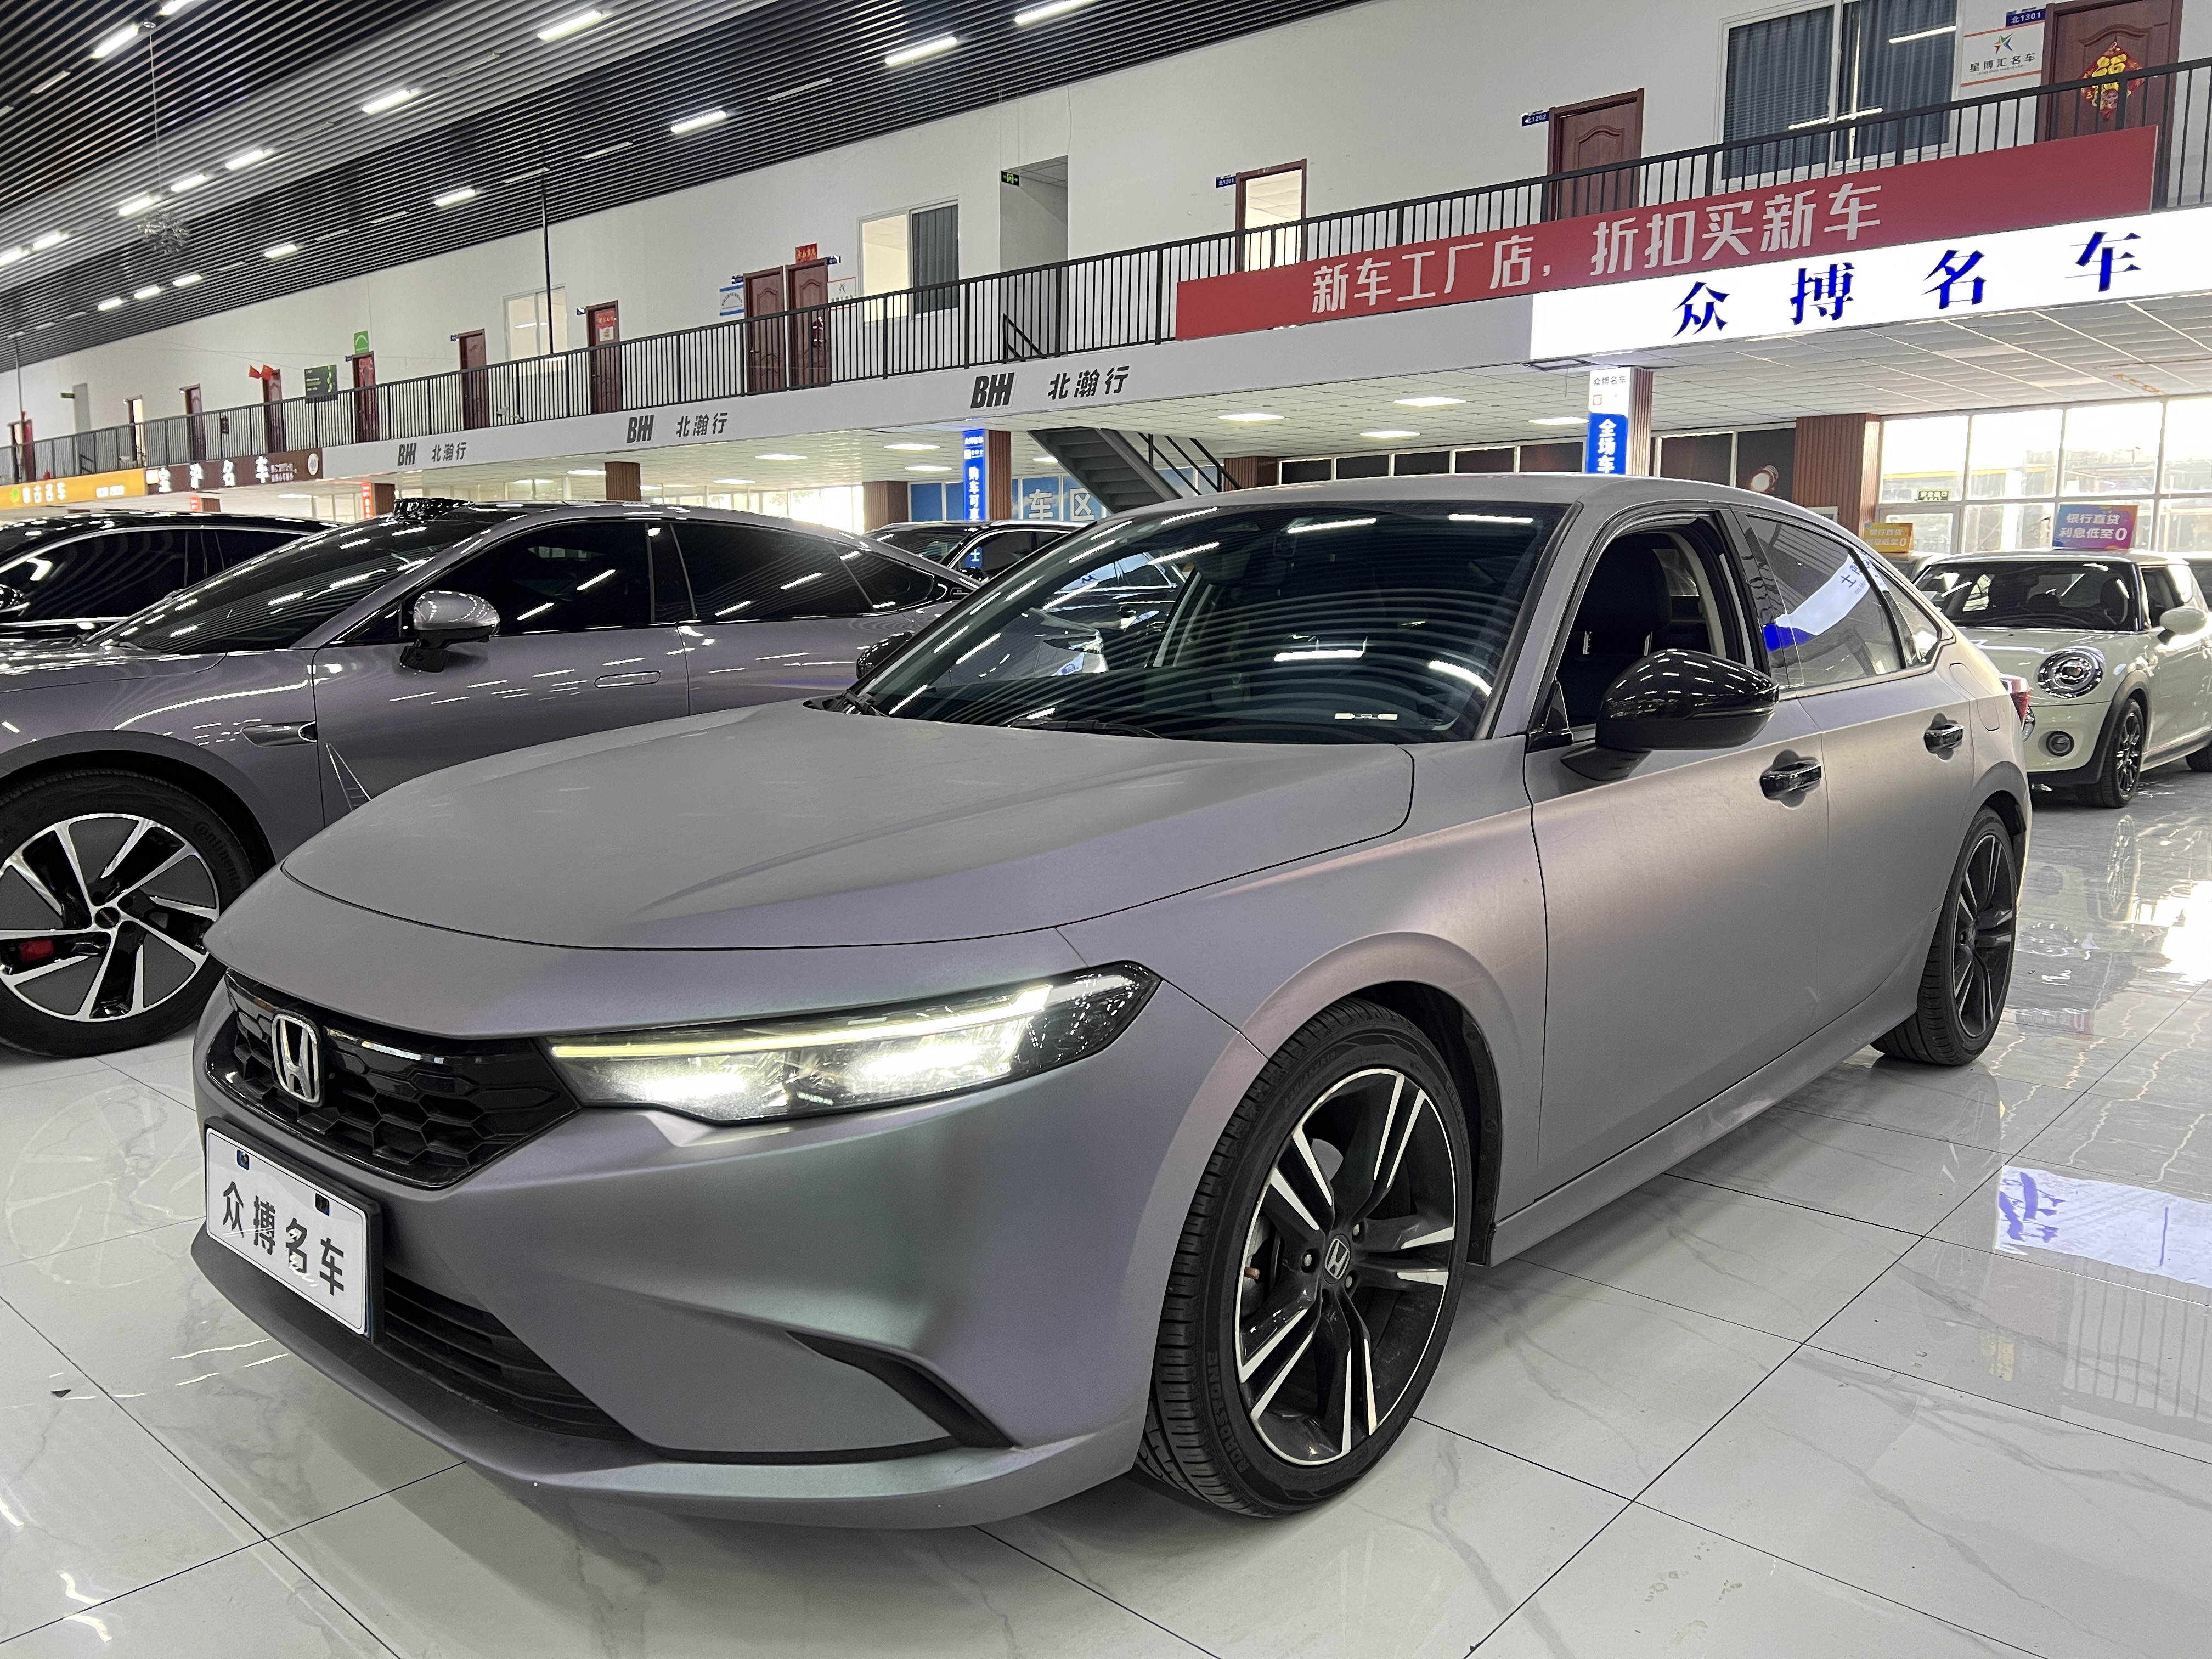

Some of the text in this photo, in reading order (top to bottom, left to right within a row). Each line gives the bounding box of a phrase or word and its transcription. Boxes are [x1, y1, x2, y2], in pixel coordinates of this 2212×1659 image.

[2011, 12, 2040, 24] 北1301
[1047, 366, 1130, 400] 北瀚行
[675, 413, 728, 438] 北瀚行
[2066, 513, 2120, 525] 银行直贷
[1207, 1351, 1251, 1473] ROADSTONE
